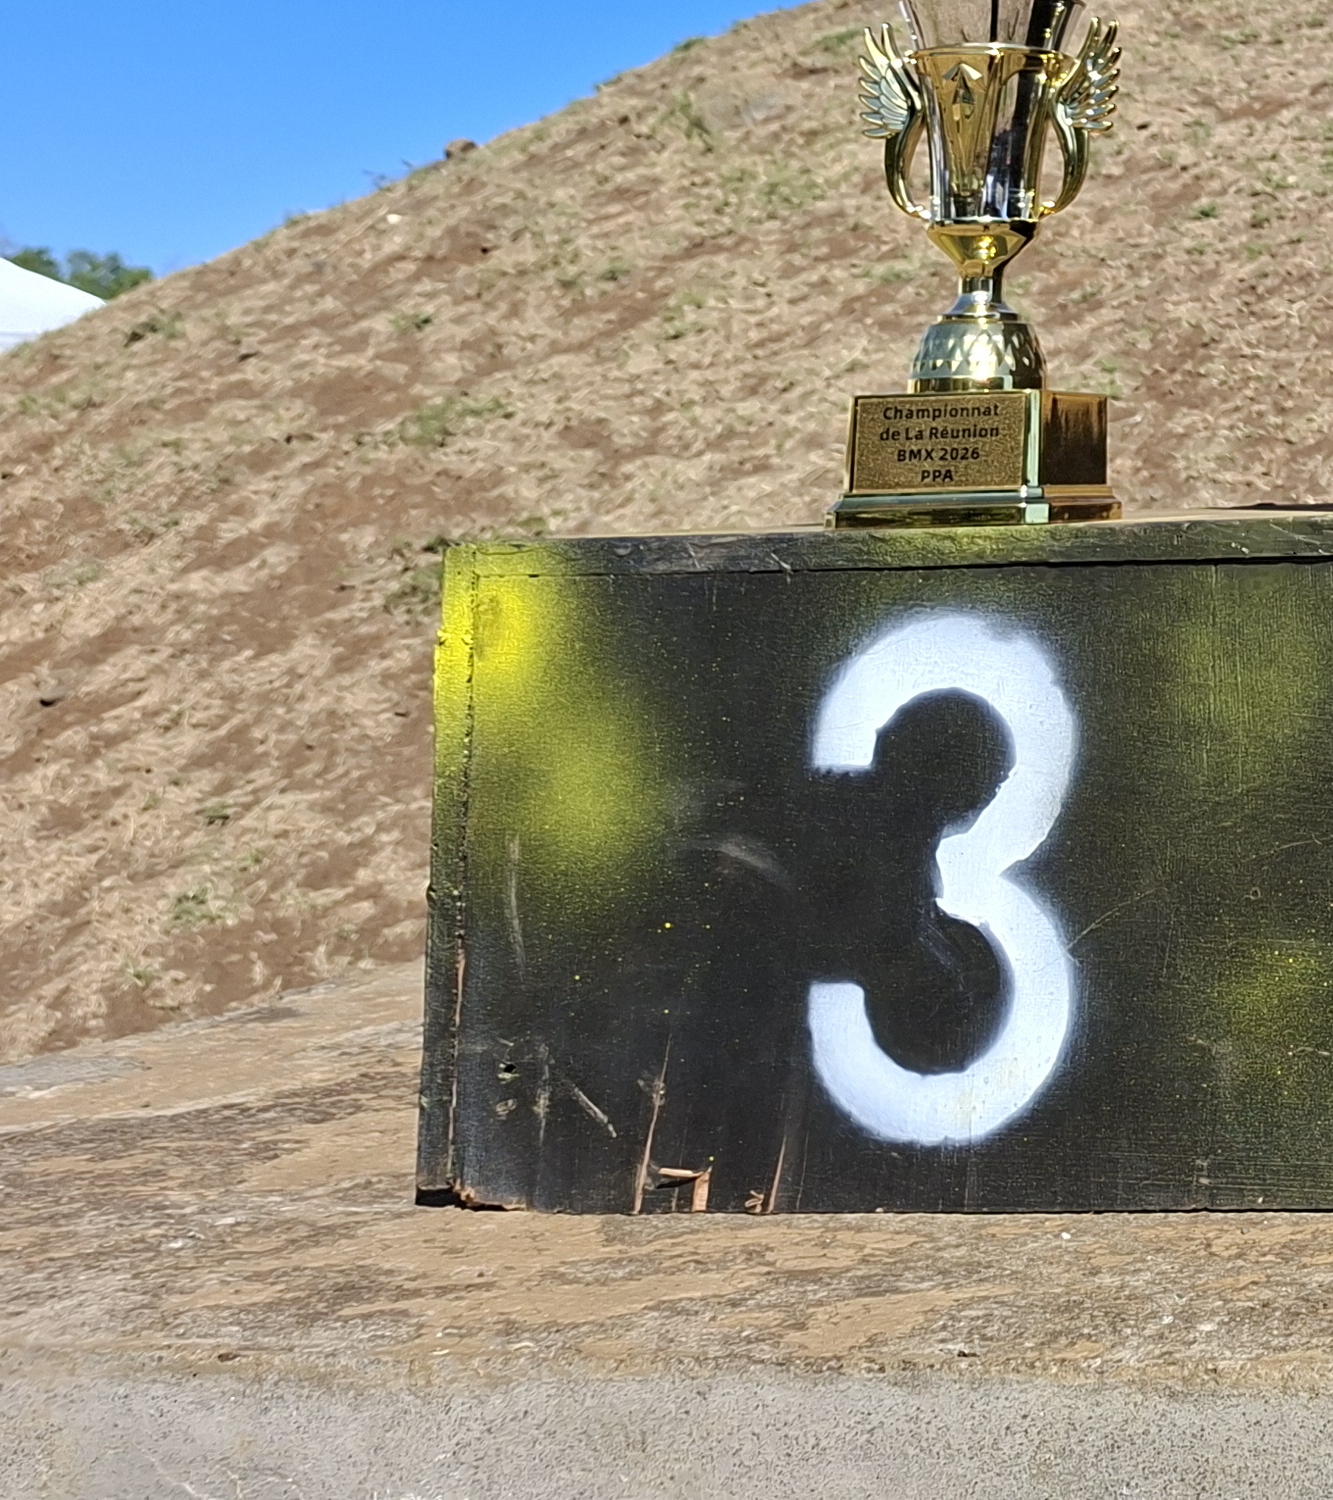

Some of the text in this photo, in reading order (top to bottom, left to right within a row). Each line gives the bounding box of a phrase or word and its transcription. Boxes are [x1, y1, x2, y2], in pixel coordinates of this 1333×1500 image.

[883, 404, 1000, 421] Championnat
[880, 424, 1000, 442] de La Réunion
[897, 447, 980, 463] BMX 2026
[921, 470, 954, 483] PPA
[808, 608, 1077, 1147] 3
